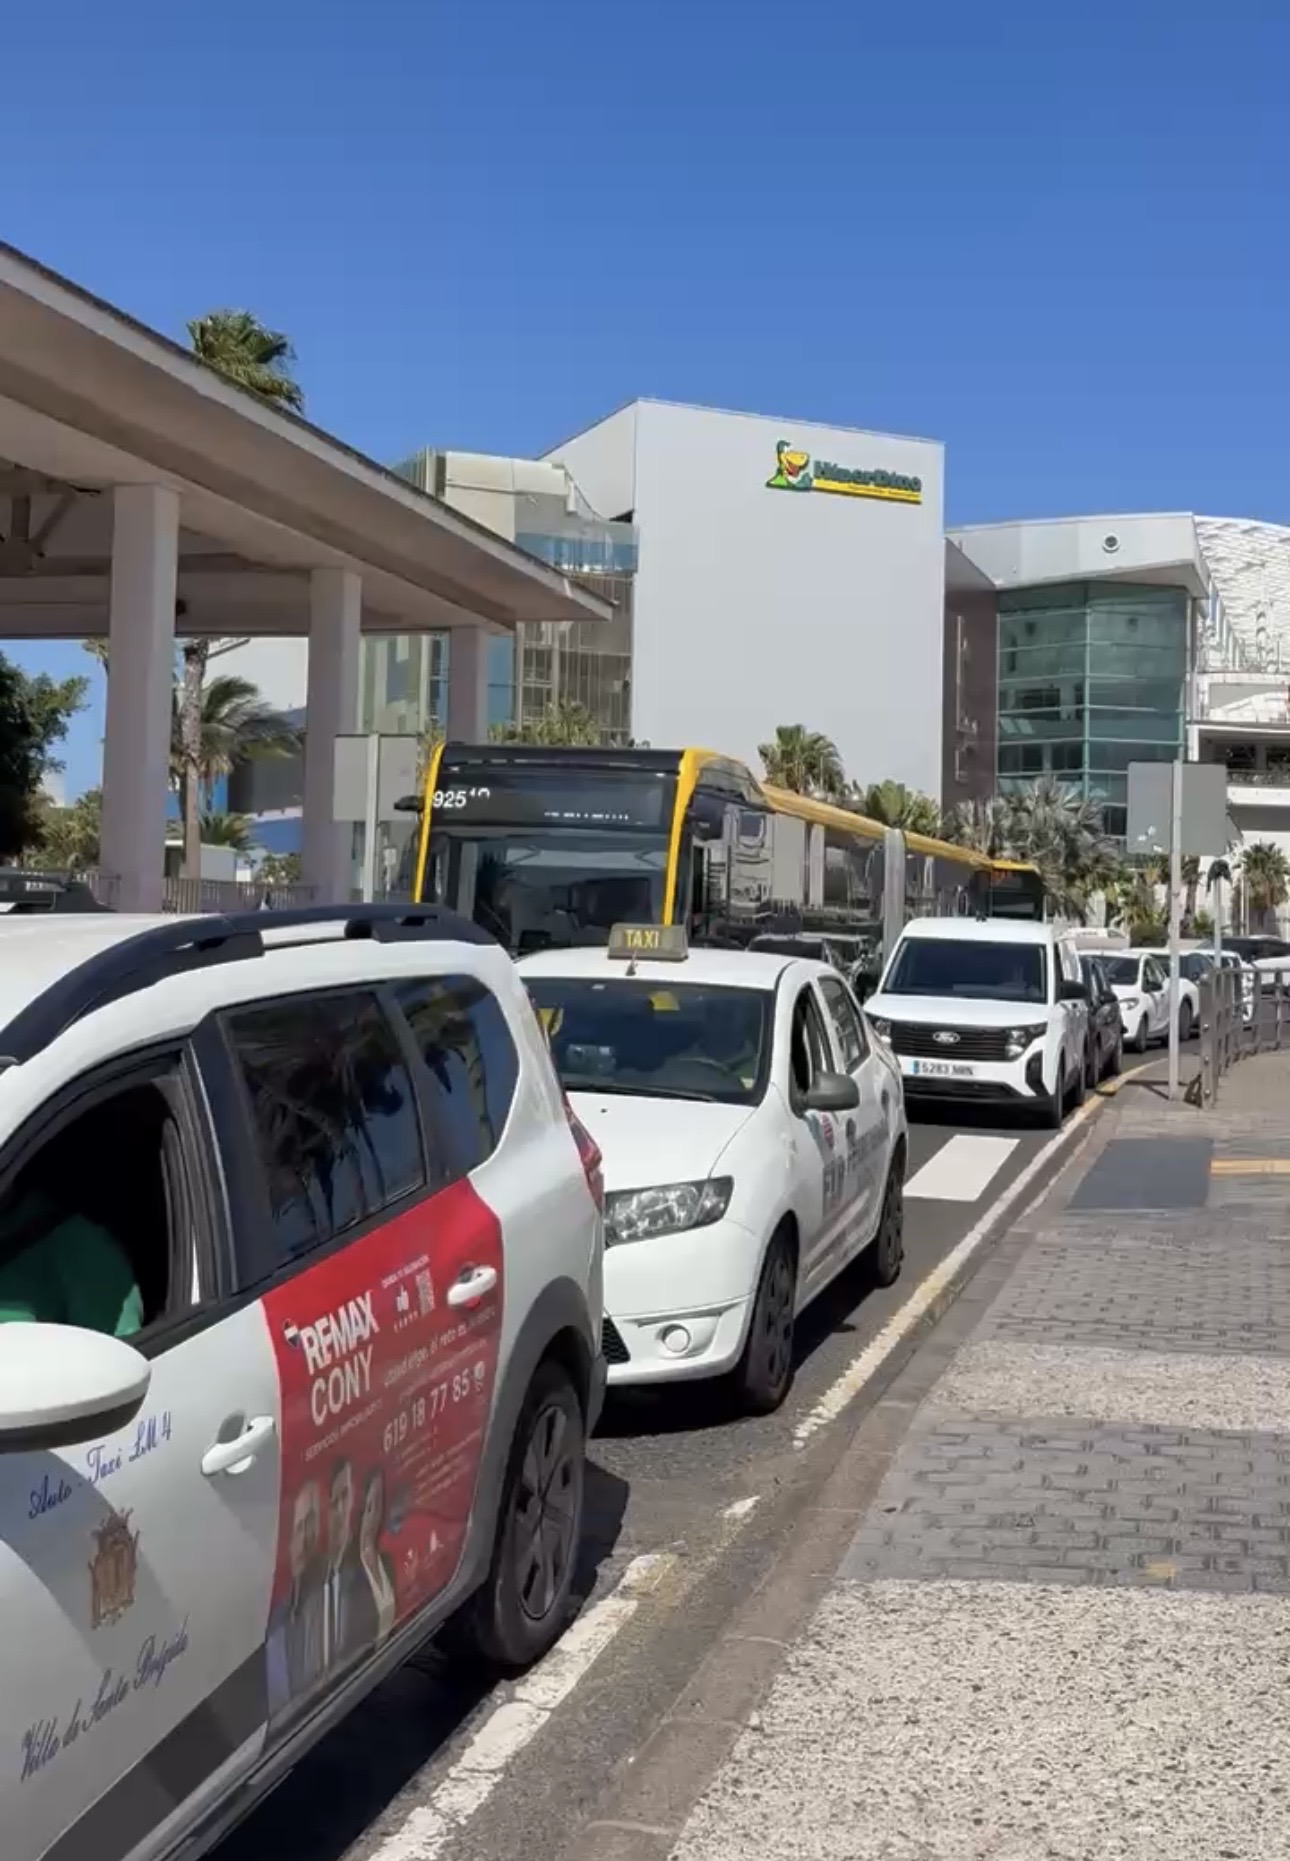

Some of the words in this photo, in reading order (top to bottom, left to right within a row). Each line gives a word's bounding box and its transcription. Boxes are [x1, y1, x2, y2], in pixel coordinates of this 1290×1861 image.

[625, 929, 660, 948] TAXI
[300, 1289, 380, 1376] REMAX
[311, 1344, 374, 1426] CONY
[383, 1410, 407, 1454] 619
[430, 1382, 448, 1419] 77
[453, 1368, 470, 1402] 85
[28, 1475, 72, 1519] Auto
[86, 1444, 122, 1485] Taxi
